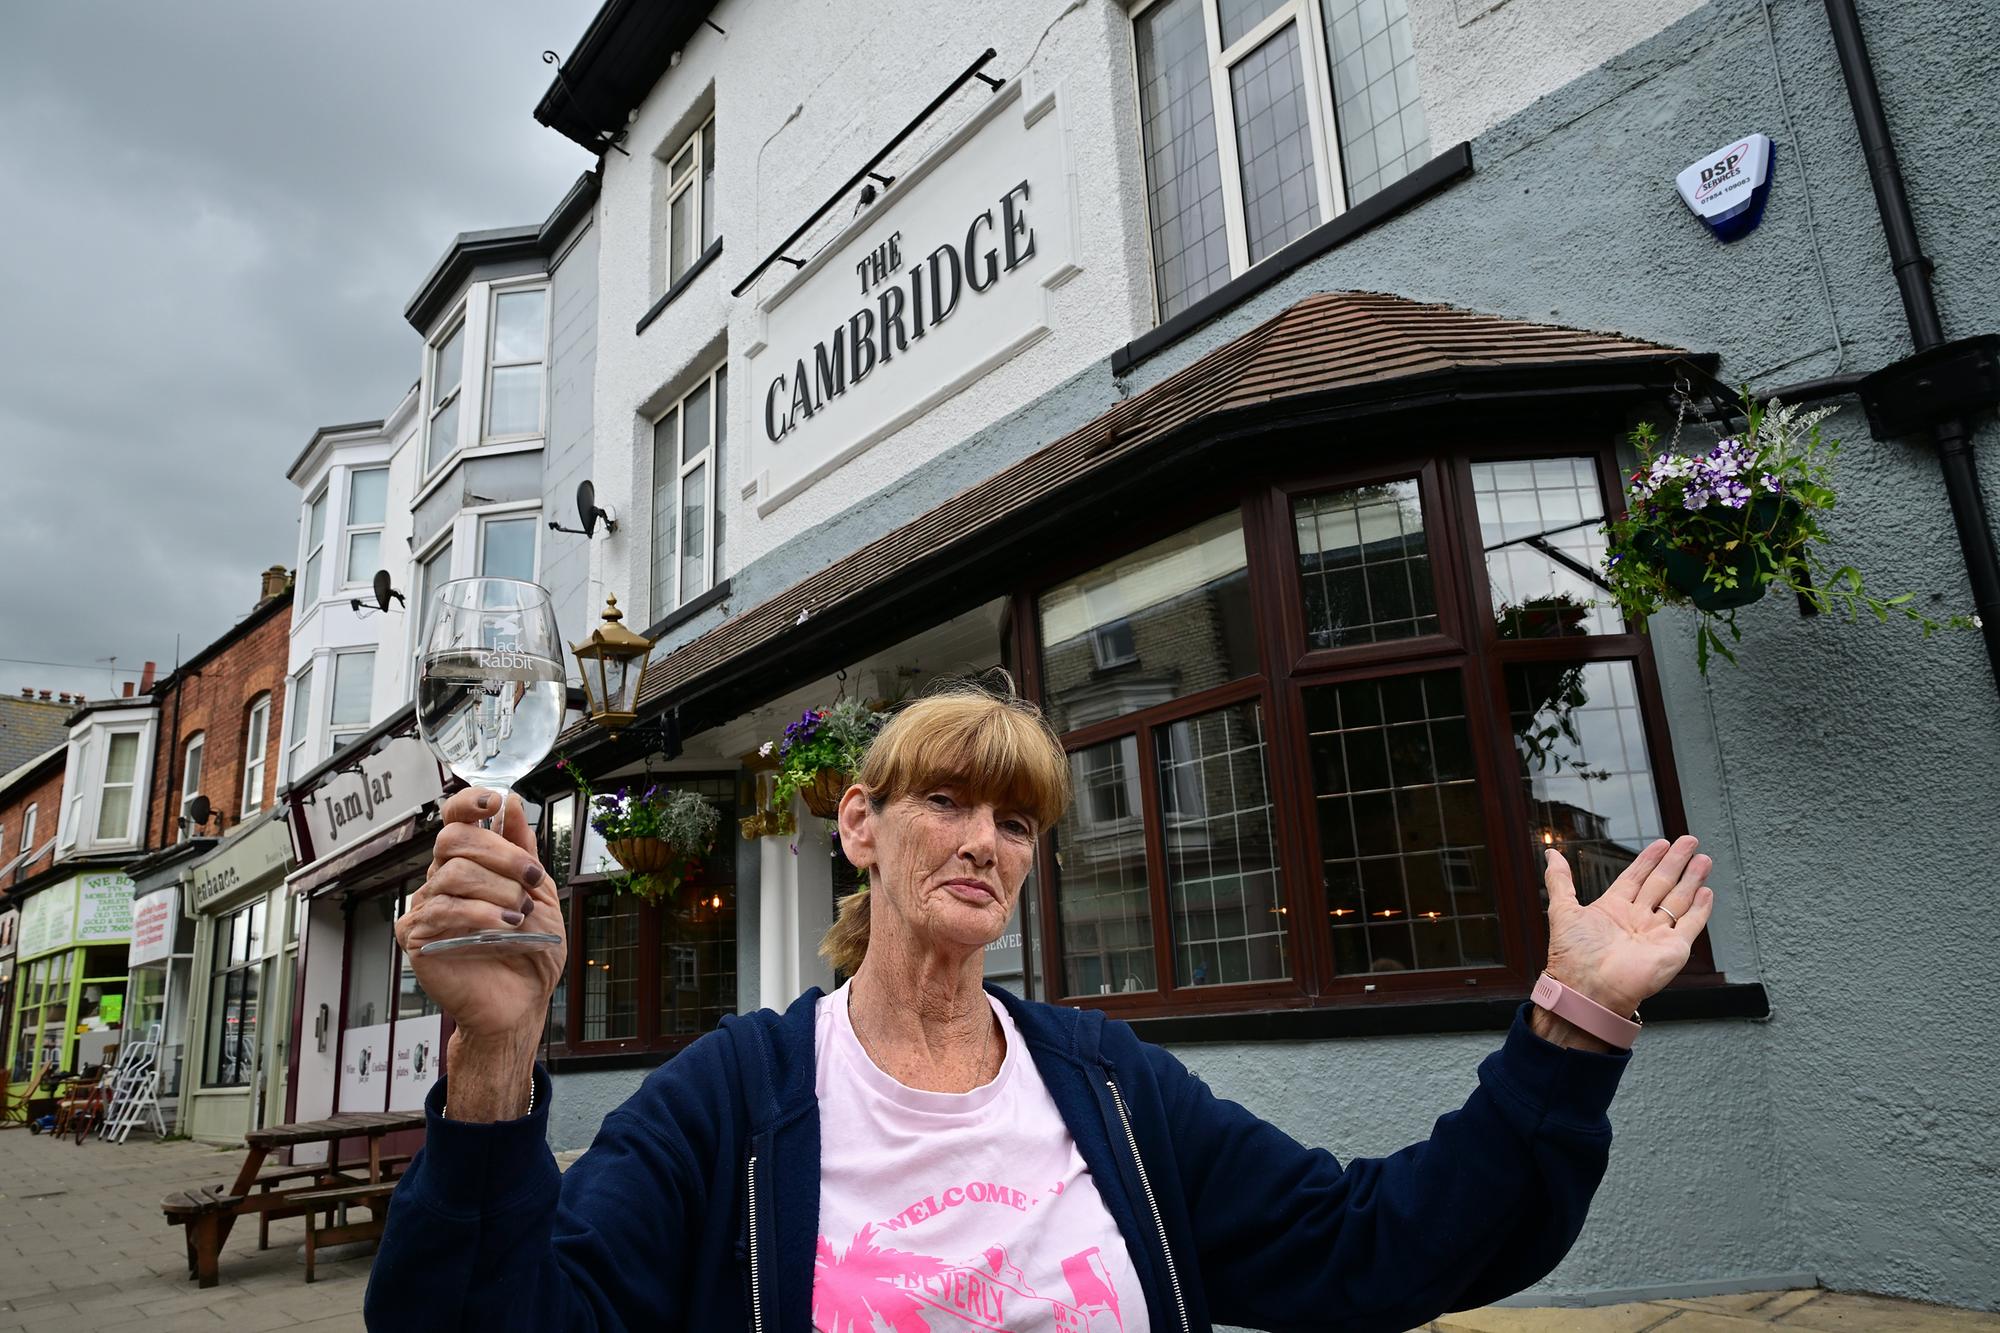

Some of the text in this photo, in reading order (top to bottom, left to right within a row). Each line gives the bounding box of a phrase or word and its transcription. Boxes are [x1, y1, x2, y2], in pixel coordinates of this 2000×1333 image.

[1700, 154, 1739, 183] DSP
[1703, 167, 1741, 191] SERVICES
[856, 230, 902, 295] THE
[765, 179, 1036, 442] CAMBRIDGE
[479, 652, 533, 671] Rabbit
[490, 636, 525, 656] Jack
[324, 770, 392, 841] Jam Jar
[88, 874, 132, 888] WE BU
[877, 1182, 1027, 1231] WELCOME
[904, 1272, 1004, 1325] BEVERLY
